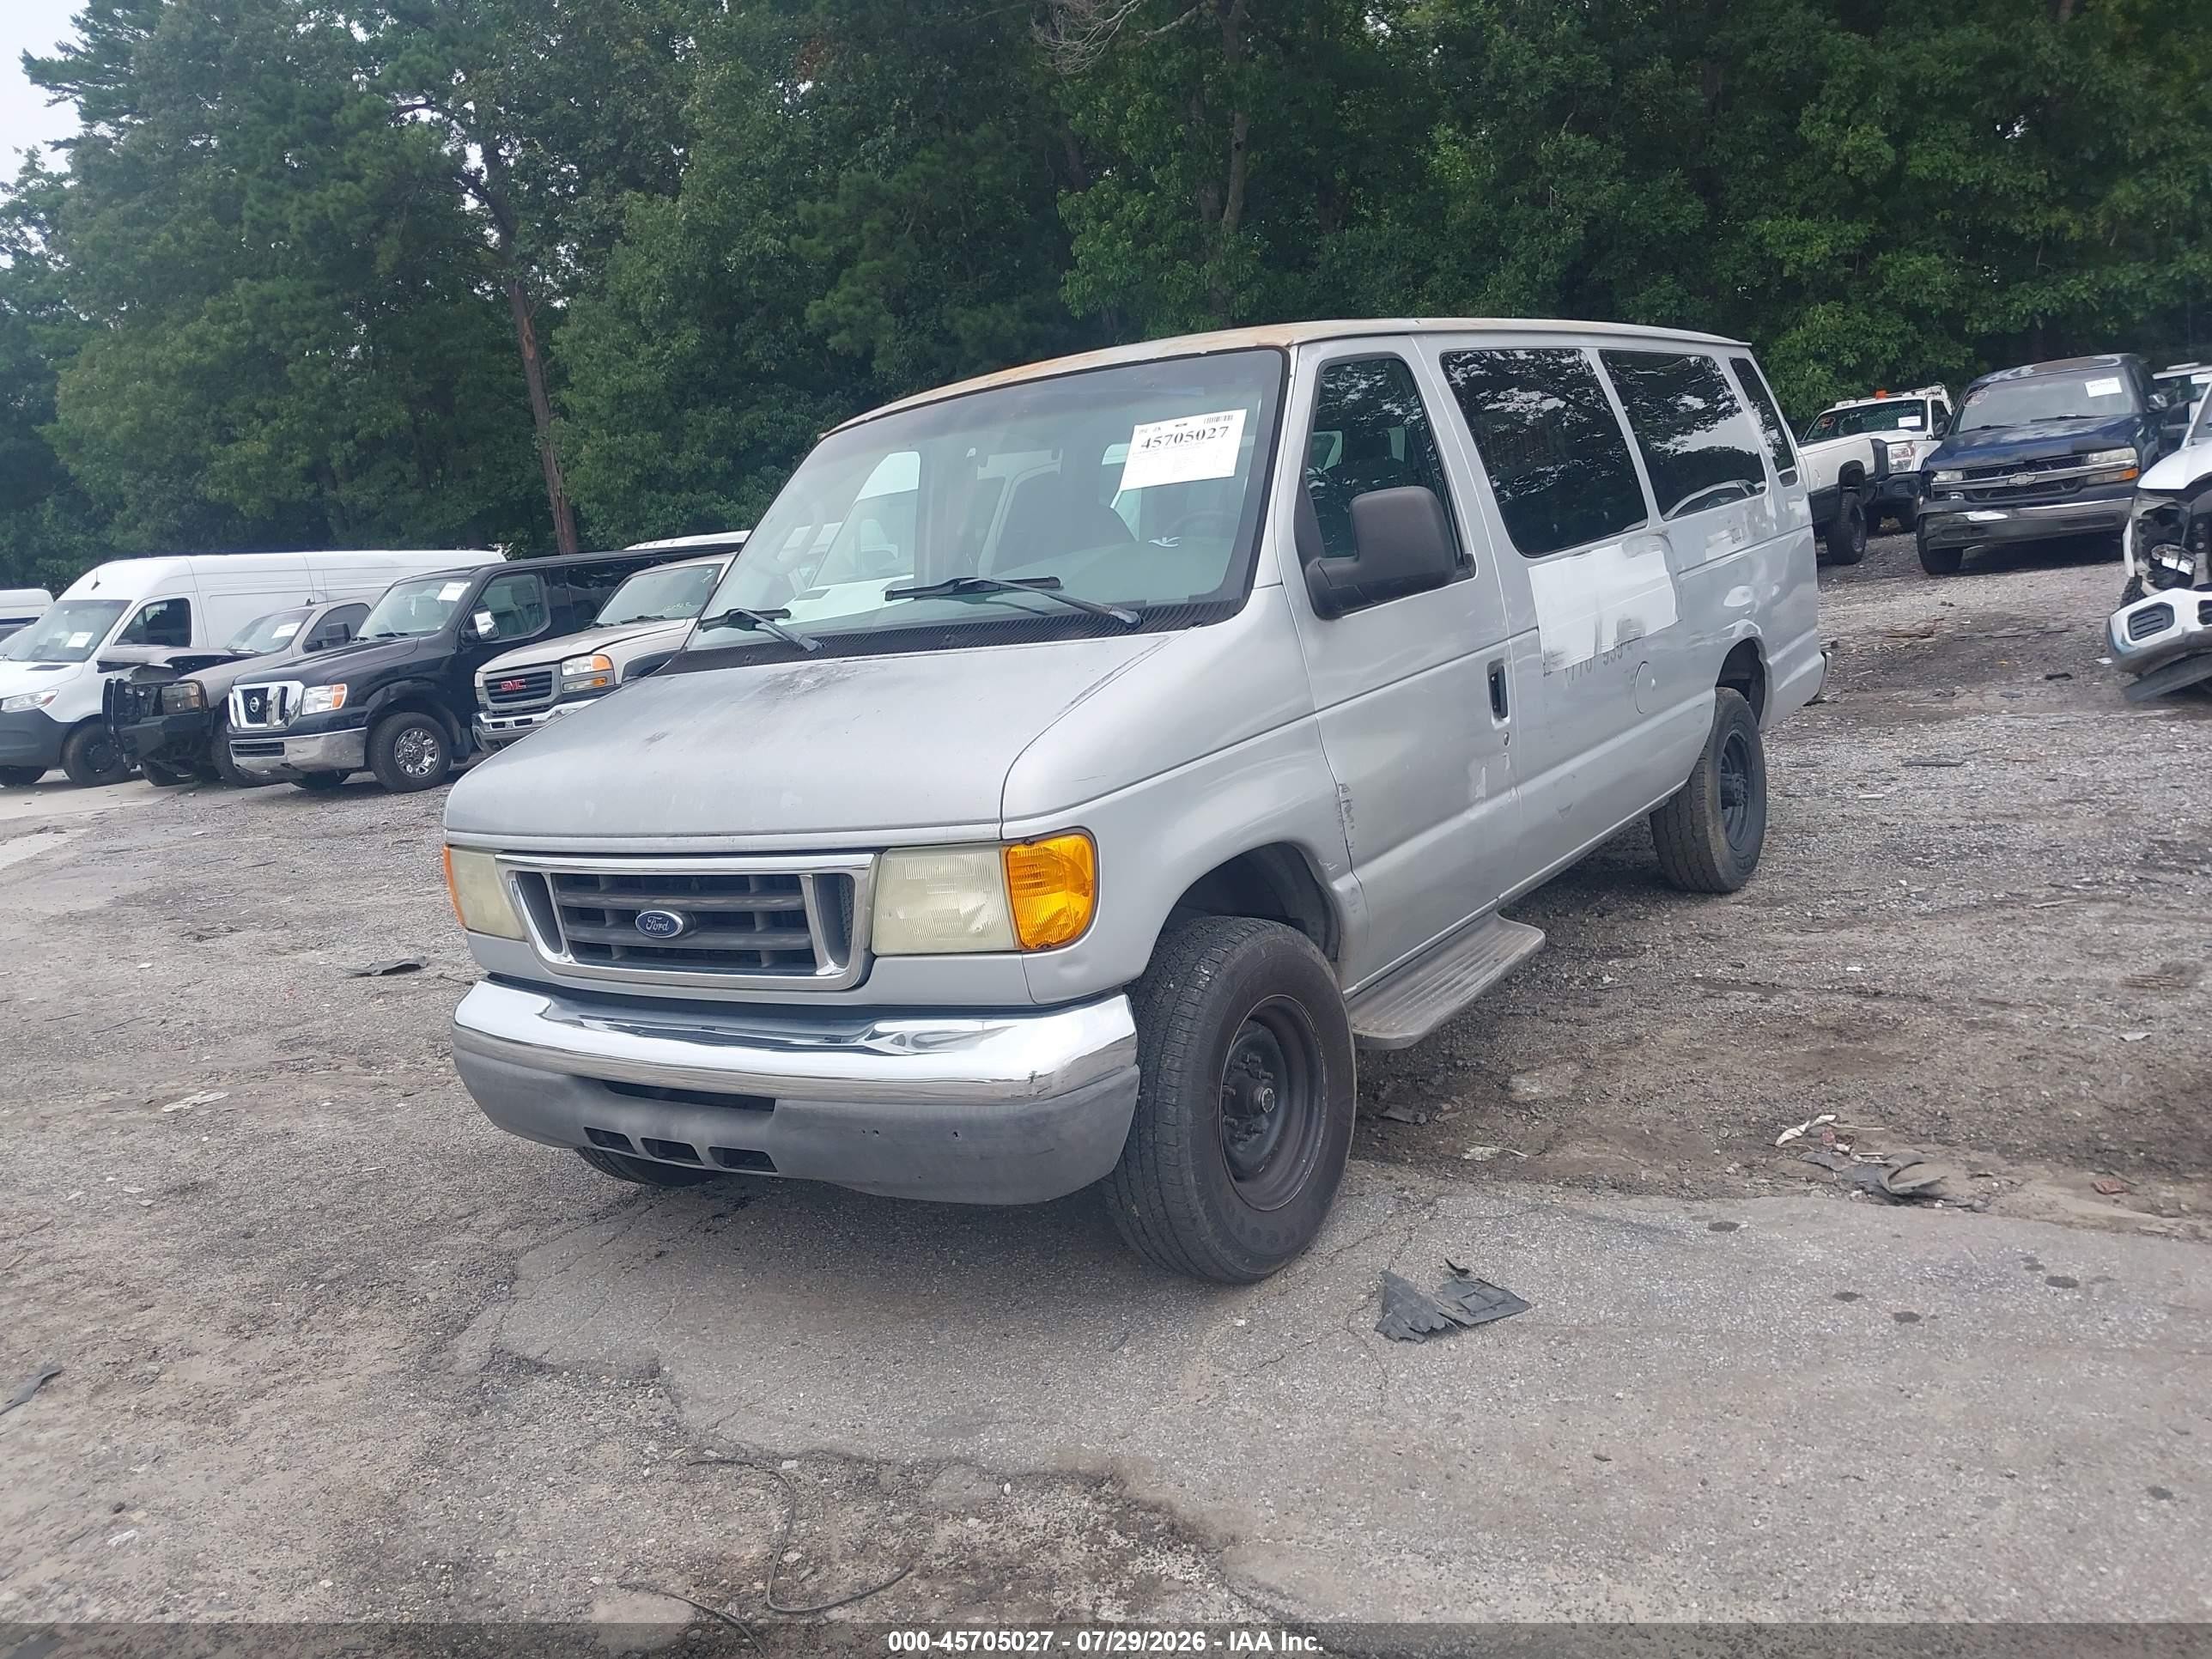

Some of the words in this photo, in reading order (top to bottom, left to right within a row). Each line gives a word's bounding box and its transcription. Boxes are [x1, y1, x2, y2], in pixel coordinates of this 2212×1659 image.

[1141, 426, 1230, 450] 45705027
[501, 678, 526, 691] GMC
[646, 915, 670, 932] Ford
